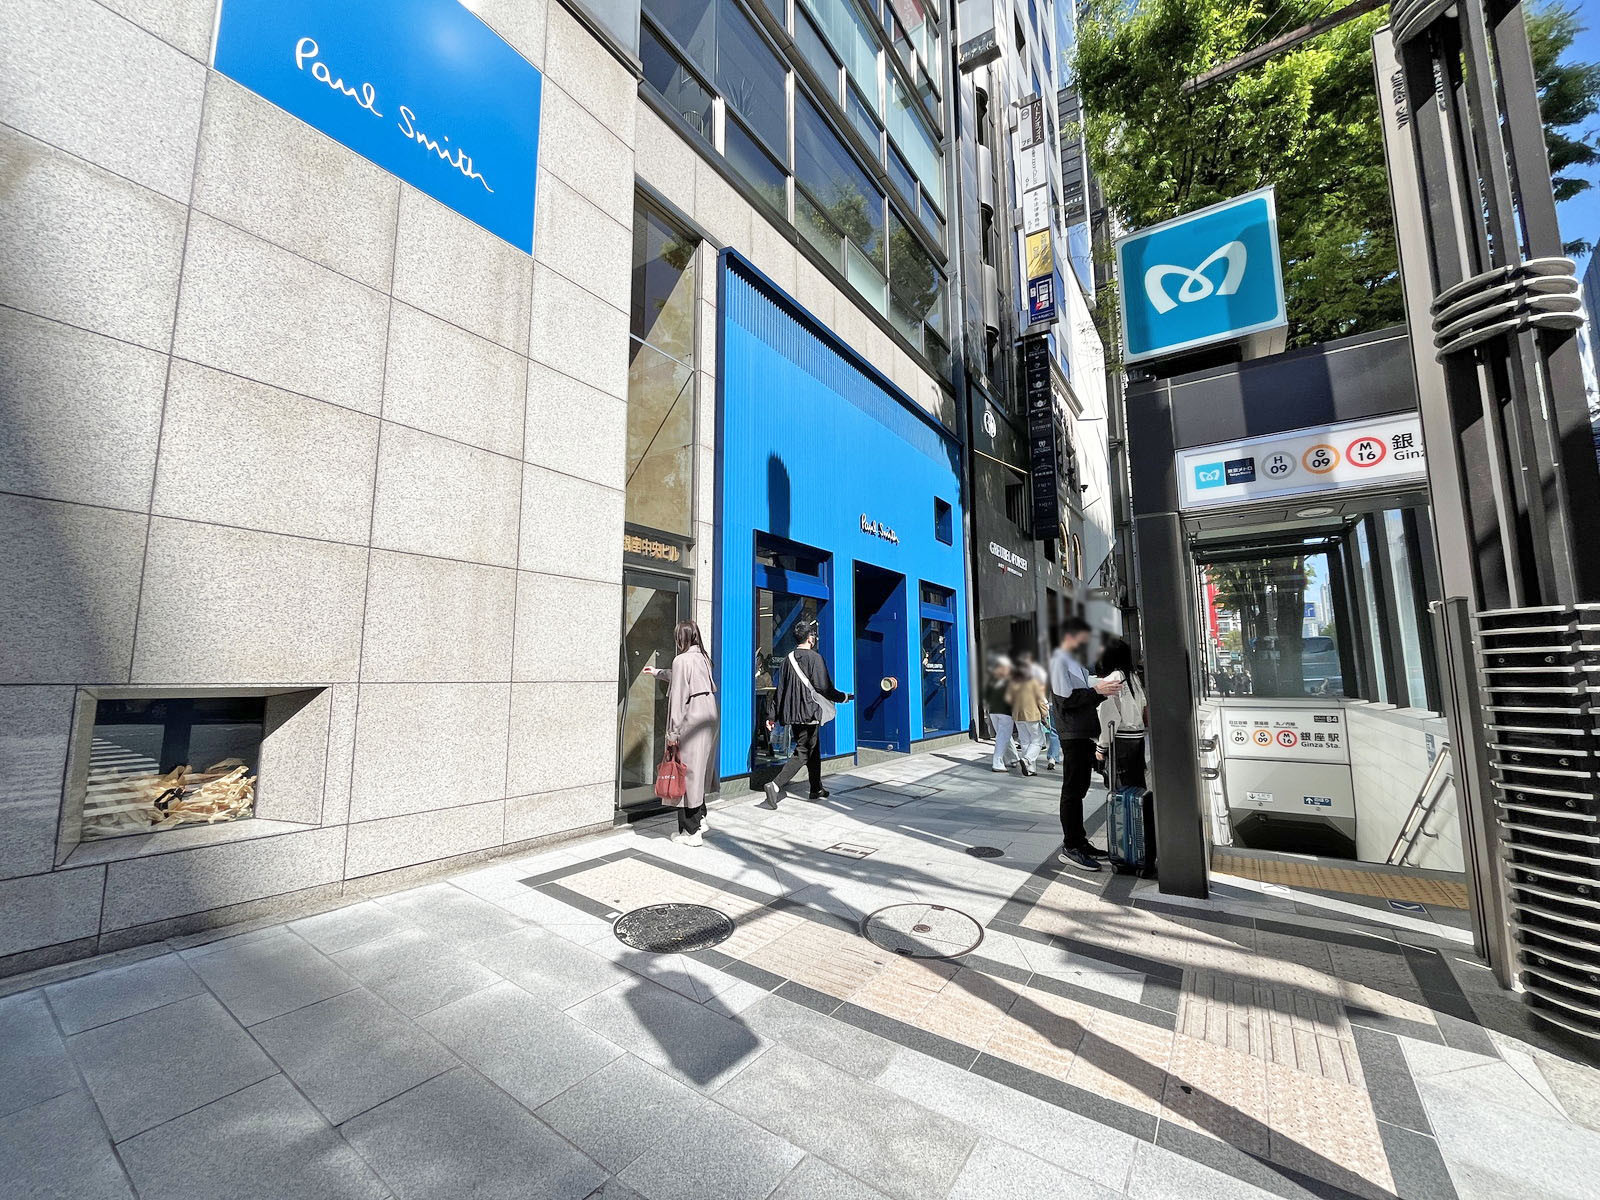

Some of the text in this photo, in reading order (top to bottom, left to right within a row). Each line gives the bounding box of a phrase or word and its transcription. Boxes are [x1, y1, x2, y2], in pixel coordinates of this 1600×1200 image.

[295, 37, 494, 193] Paul Smith
[1359, 442, 1373, 451] M
[1315, 449, 1325, 458] G
[1358, 451, 1376, 462] 16
[1274, 456, 1283, 464] H
[1312, 458, 1331, 468] 09
[1271, 464, 1288, 474] 09
[860, 512, 900, 544] Paul Smith
[1300, 731, 1340, 742] 銀座駅
